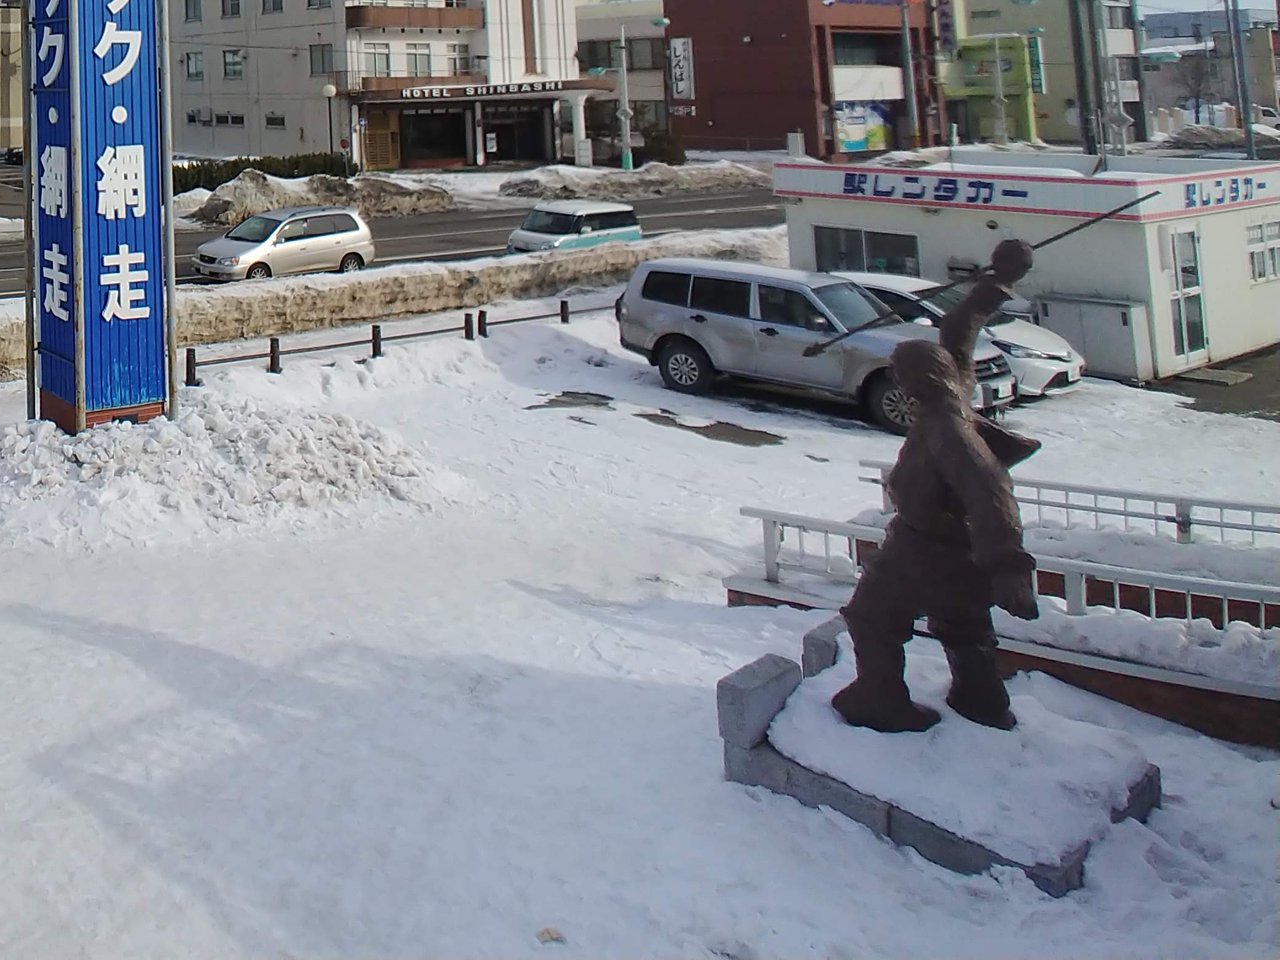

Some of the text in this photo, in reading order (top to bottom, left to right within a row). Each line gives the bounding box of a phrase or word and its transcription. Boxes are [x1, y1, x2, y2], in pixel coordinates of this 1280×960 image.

[402, 81, 563, 99] HOTEL SHINBASHI
[843, 172, 1028, 204] 駅レンタカー
